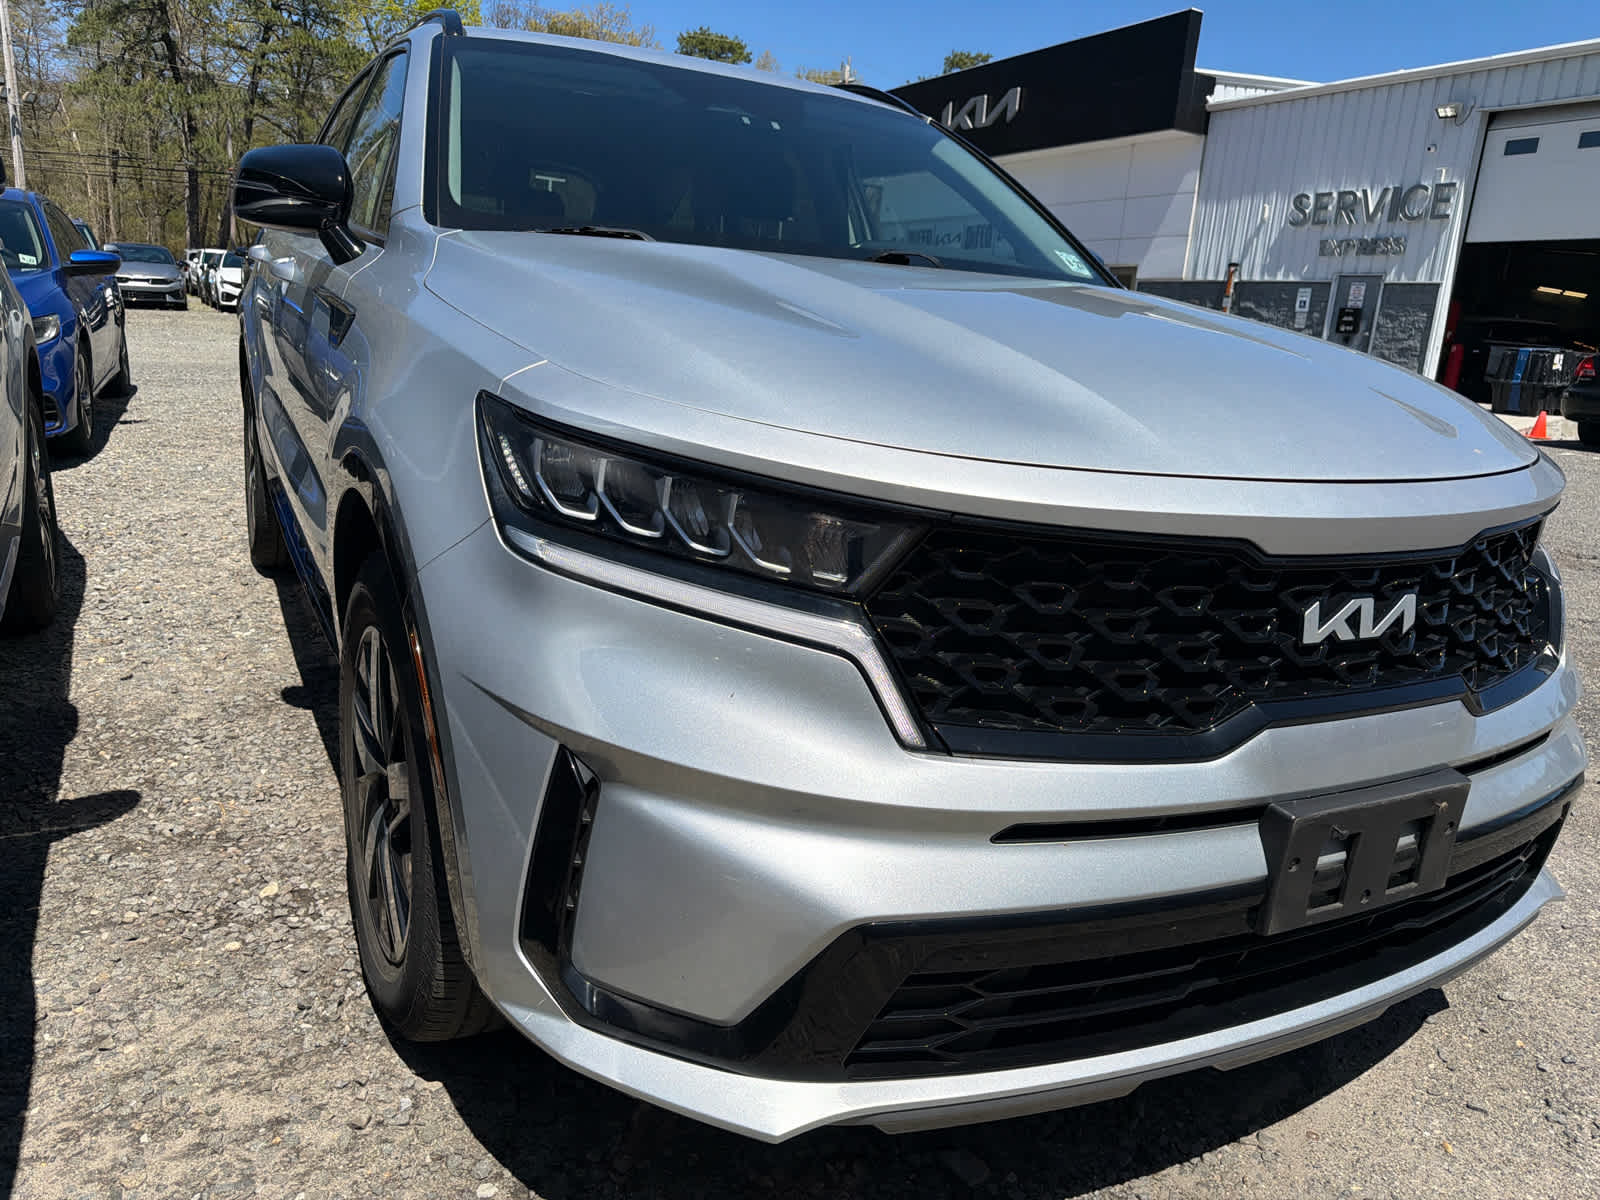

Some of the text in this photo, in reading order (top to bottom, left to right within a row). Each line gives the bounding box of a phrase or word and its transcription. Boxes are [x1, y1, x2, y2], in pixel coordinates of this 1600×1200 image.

[941, 86, 1021, 130] KIA
[1288, 182, 1457, 227] SERVICE
[1319, 235, 1407, 256] EXPRESS
[1303, 593, 1417, 643] KIA
